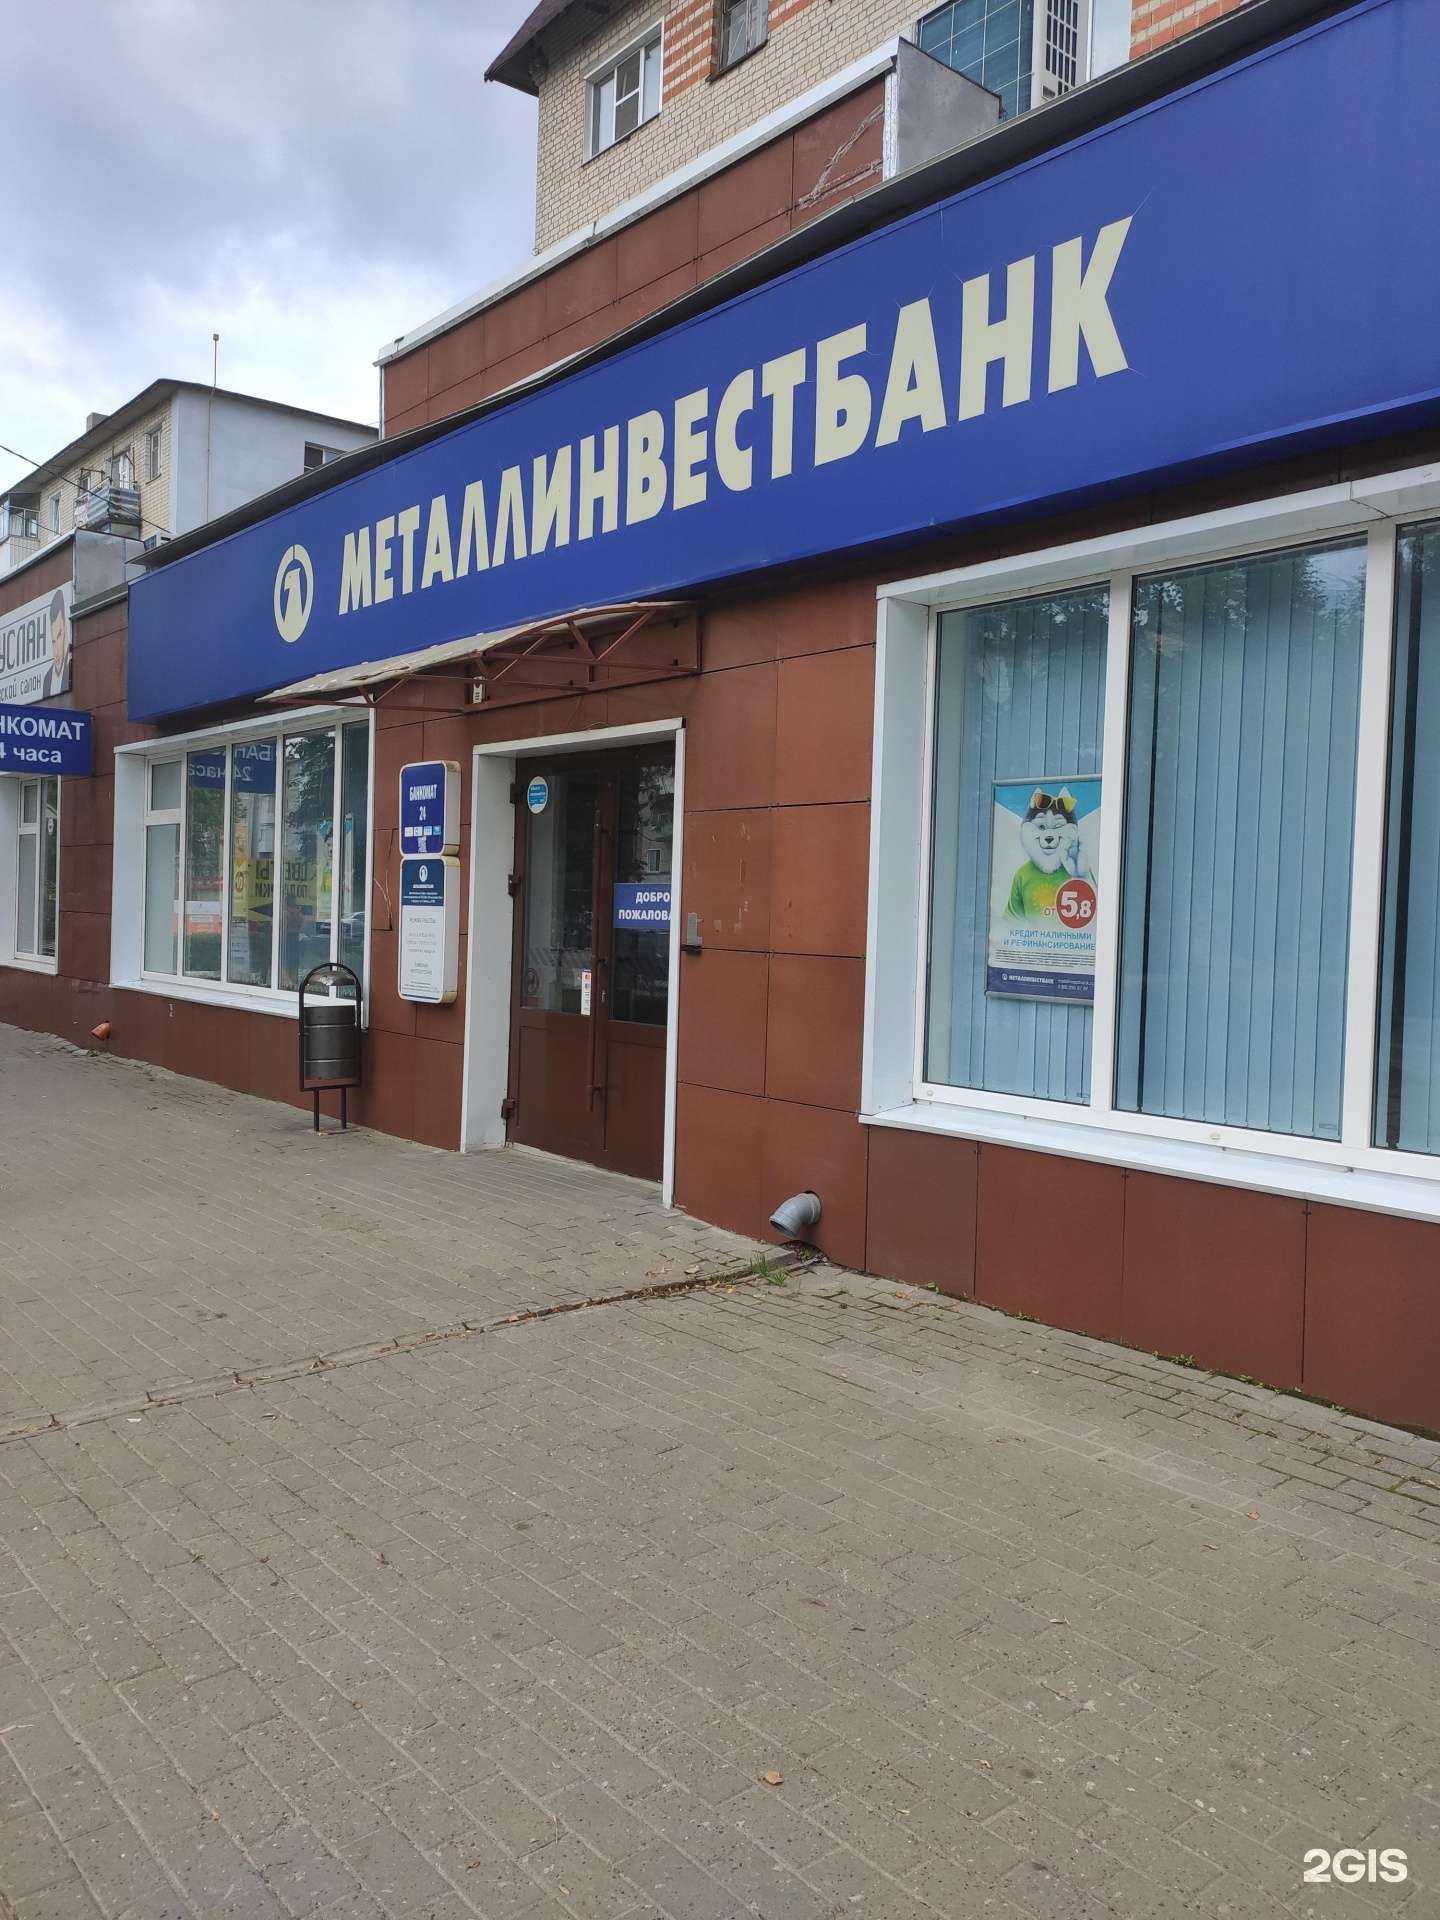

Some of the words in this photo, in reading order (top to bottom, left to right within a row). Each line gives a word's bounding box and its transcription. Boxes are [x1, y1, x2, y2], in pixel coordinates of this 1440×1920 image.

[338, 216, 1133, 616] МЕТАЛЛИНВЕСТБАНК
[20, 674, 42, 695] салон
[13, 747, 62, 764] часа
[409, 784, 437, 801] БАНКОМАТ
[418, 805, 427, 821] 24
[635, 891, 671, 904] ДОБРО
[1009, 929, 1038, 938] КРЕДИТ
[1040, 930, 1092, 941] НАЛИЧНЫМИ
[1011, 939, 1095, 951] РЕФИНАНСИРОВАНИЕ
